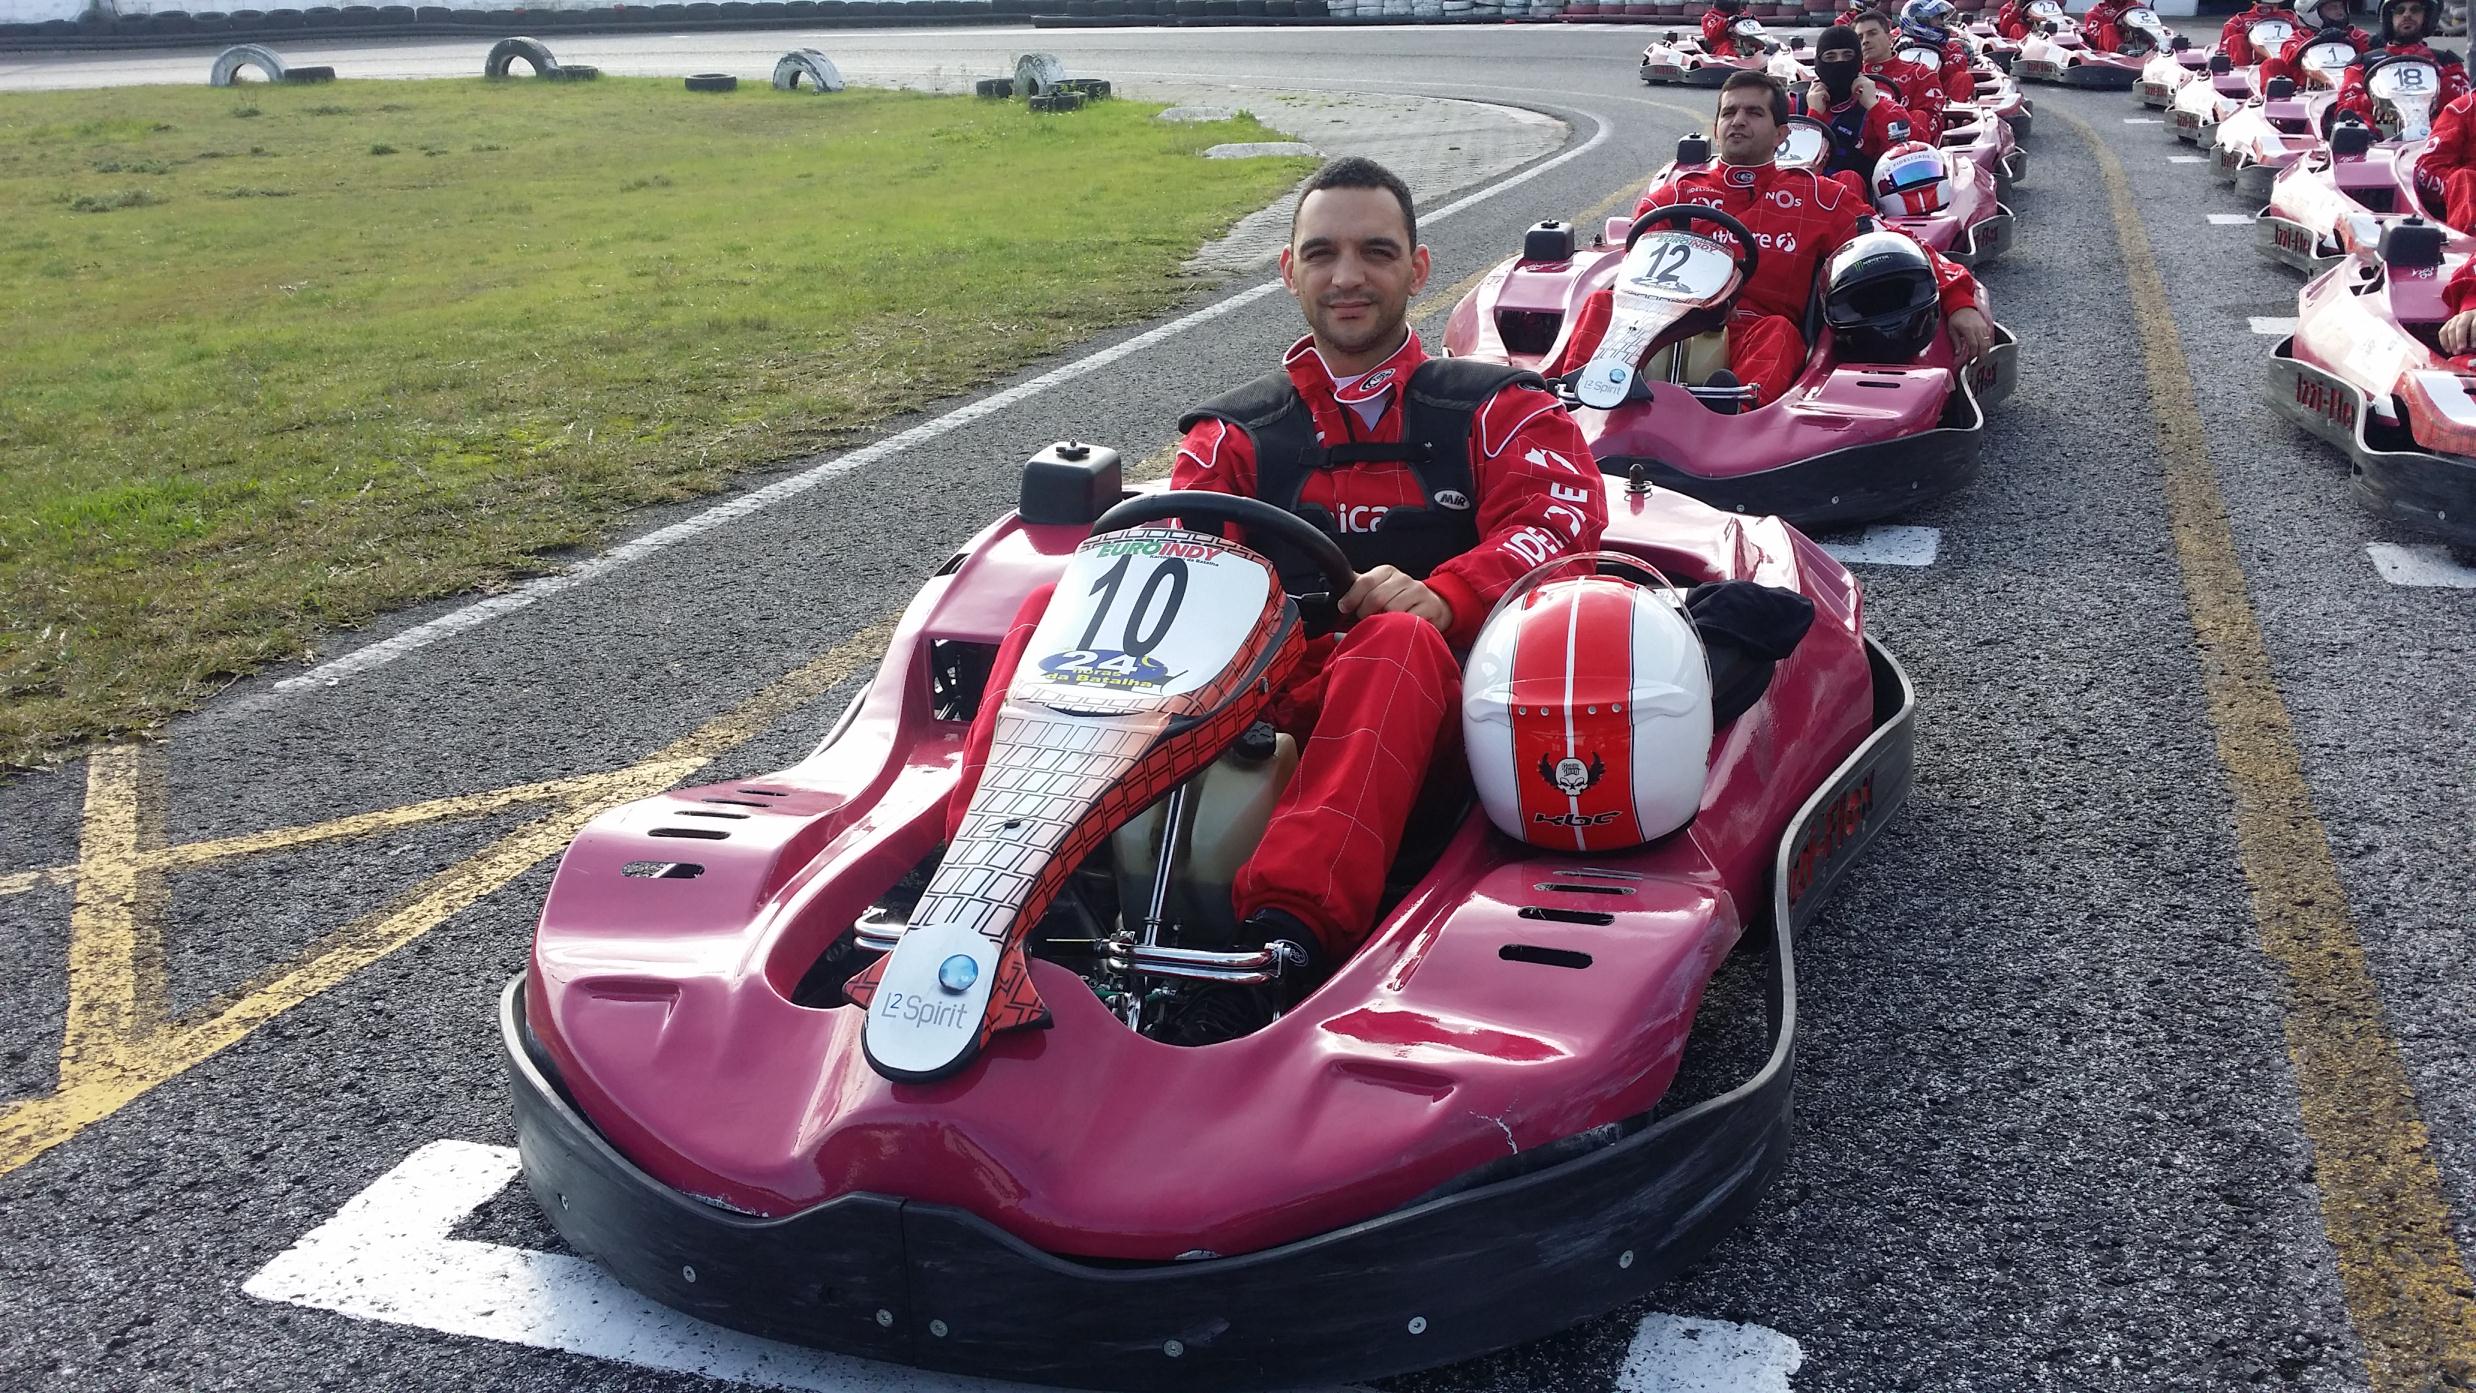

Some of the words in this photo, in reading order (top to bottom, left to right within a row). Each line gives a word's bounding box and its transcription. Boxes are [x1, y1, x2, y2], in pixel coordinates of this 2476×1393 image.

[2138, 12, 2149, 20] 2
[1743, 20, 1756, 31] 15
[2274, 25, 2282, 37] 7
[2328, 47, 2337, 62] 1
[2393, 68, 2423, 86] 18
[1645, 242, 1691, 282] 12
[1096, 541, 1224, 561] EUROINDY
[1076, 554, 1189, 658] 10
[1055, 650, 1138, 675] 24
[1045, 672, 1070, 681] da
[1075, 674, 1153, 688] Batalha
[903, 994, 968, 1030] Spirit
